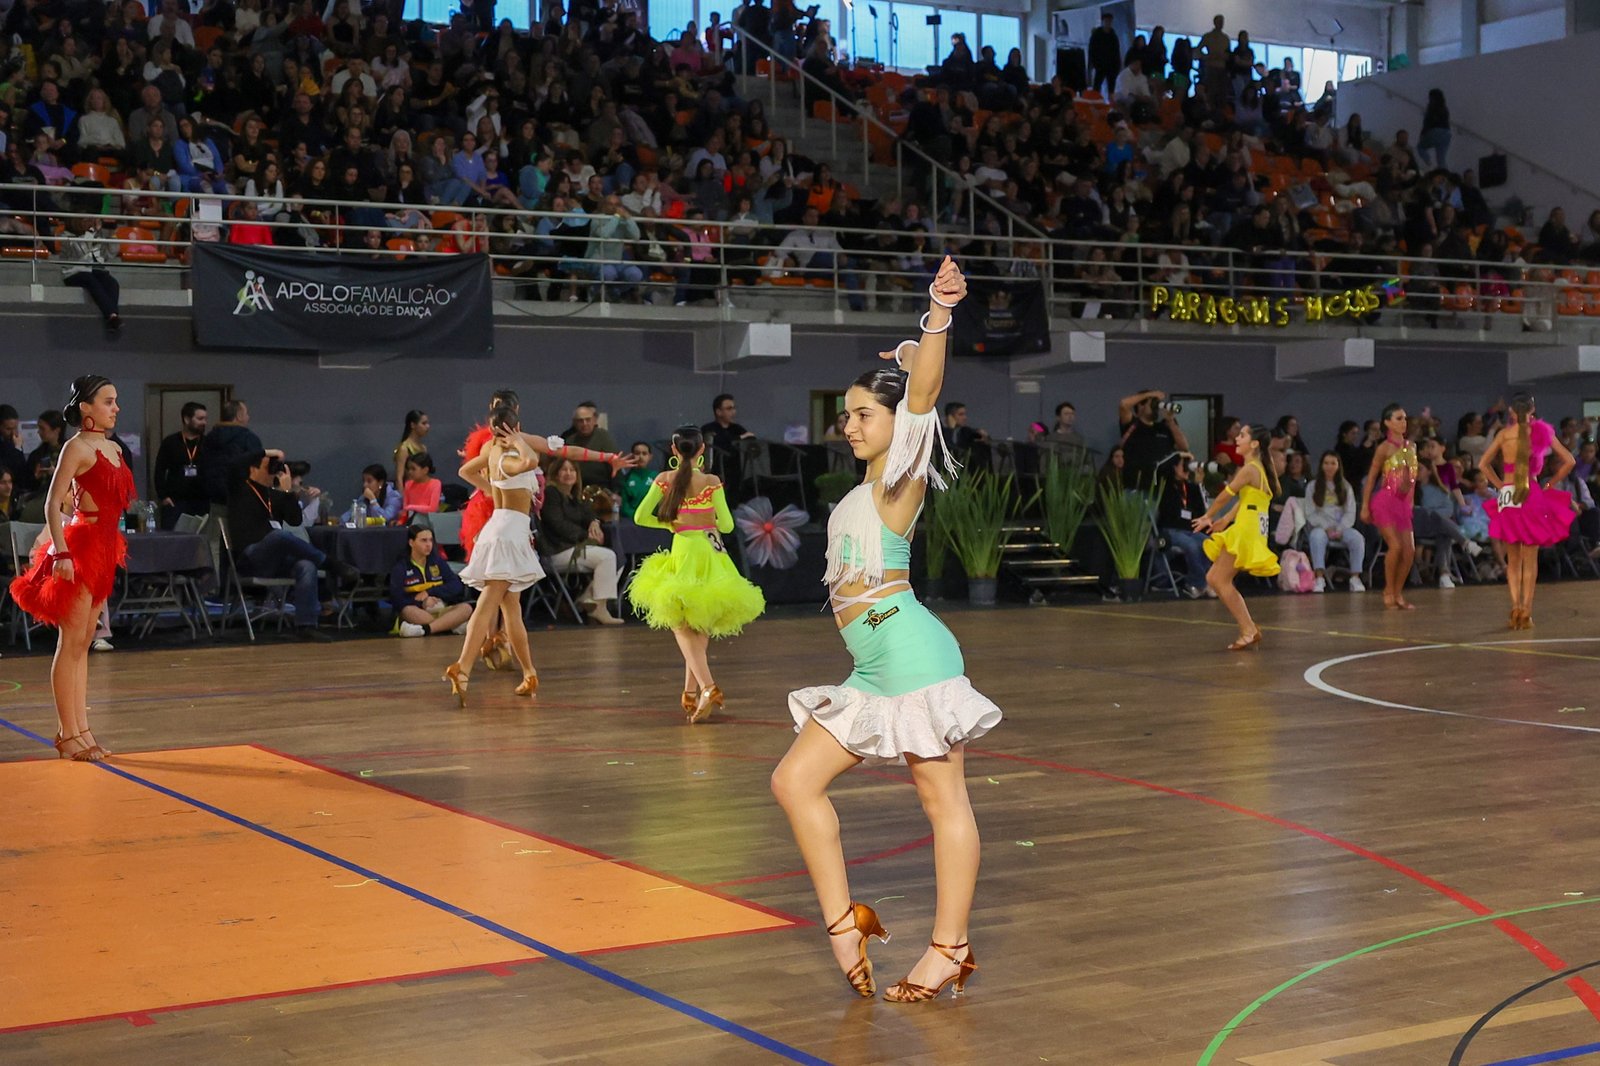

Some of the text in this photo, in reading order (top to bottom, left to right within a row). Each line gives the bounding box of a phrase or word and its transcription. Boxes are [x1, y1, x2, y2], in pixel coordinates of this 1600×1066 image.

[304, 302, 432, 319] ASSOCIAÇÃO DE DANÇA
